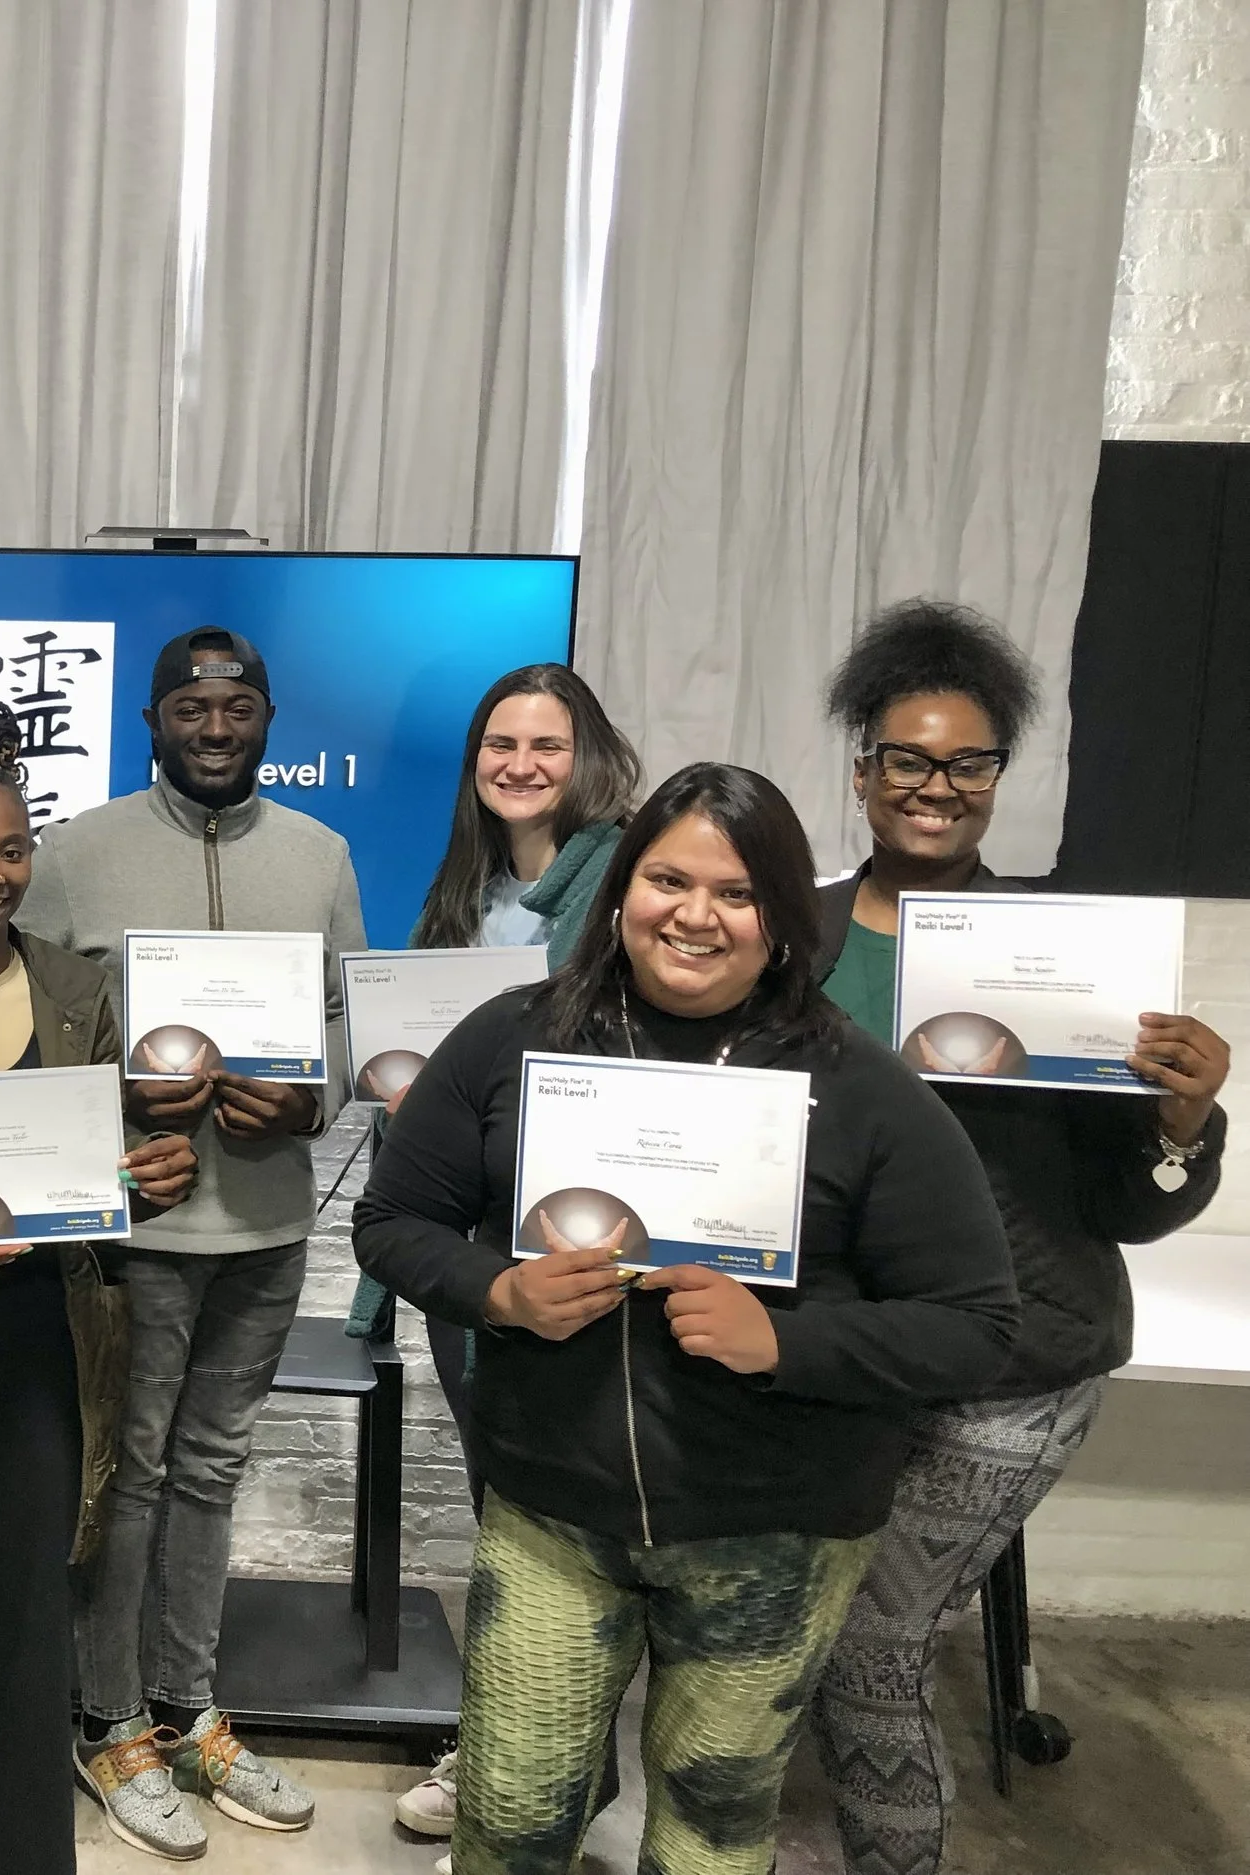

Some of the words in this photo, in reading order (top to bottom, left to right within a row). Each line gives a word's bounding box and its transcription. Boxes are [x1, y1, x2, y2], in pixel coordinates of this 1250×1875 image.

[257, 751, 326, 787] evel
[345, 754, 356, 787] 1
[914, 921, 937, 931] Reiki
[940, 922, 965, 931] Level
[968, 923, 972, 931] 1
[136, 953, 153, 961] Reiki
[155, 953, 173, 961] Level
[354, 976, 371, 984] Reiki
[372, 975, 391, 983] Level
[538, 1085, 562, 1096] Reiki
[564, 1087, 589, 1098] Level
[593, 1089, 597, 1099] 1
